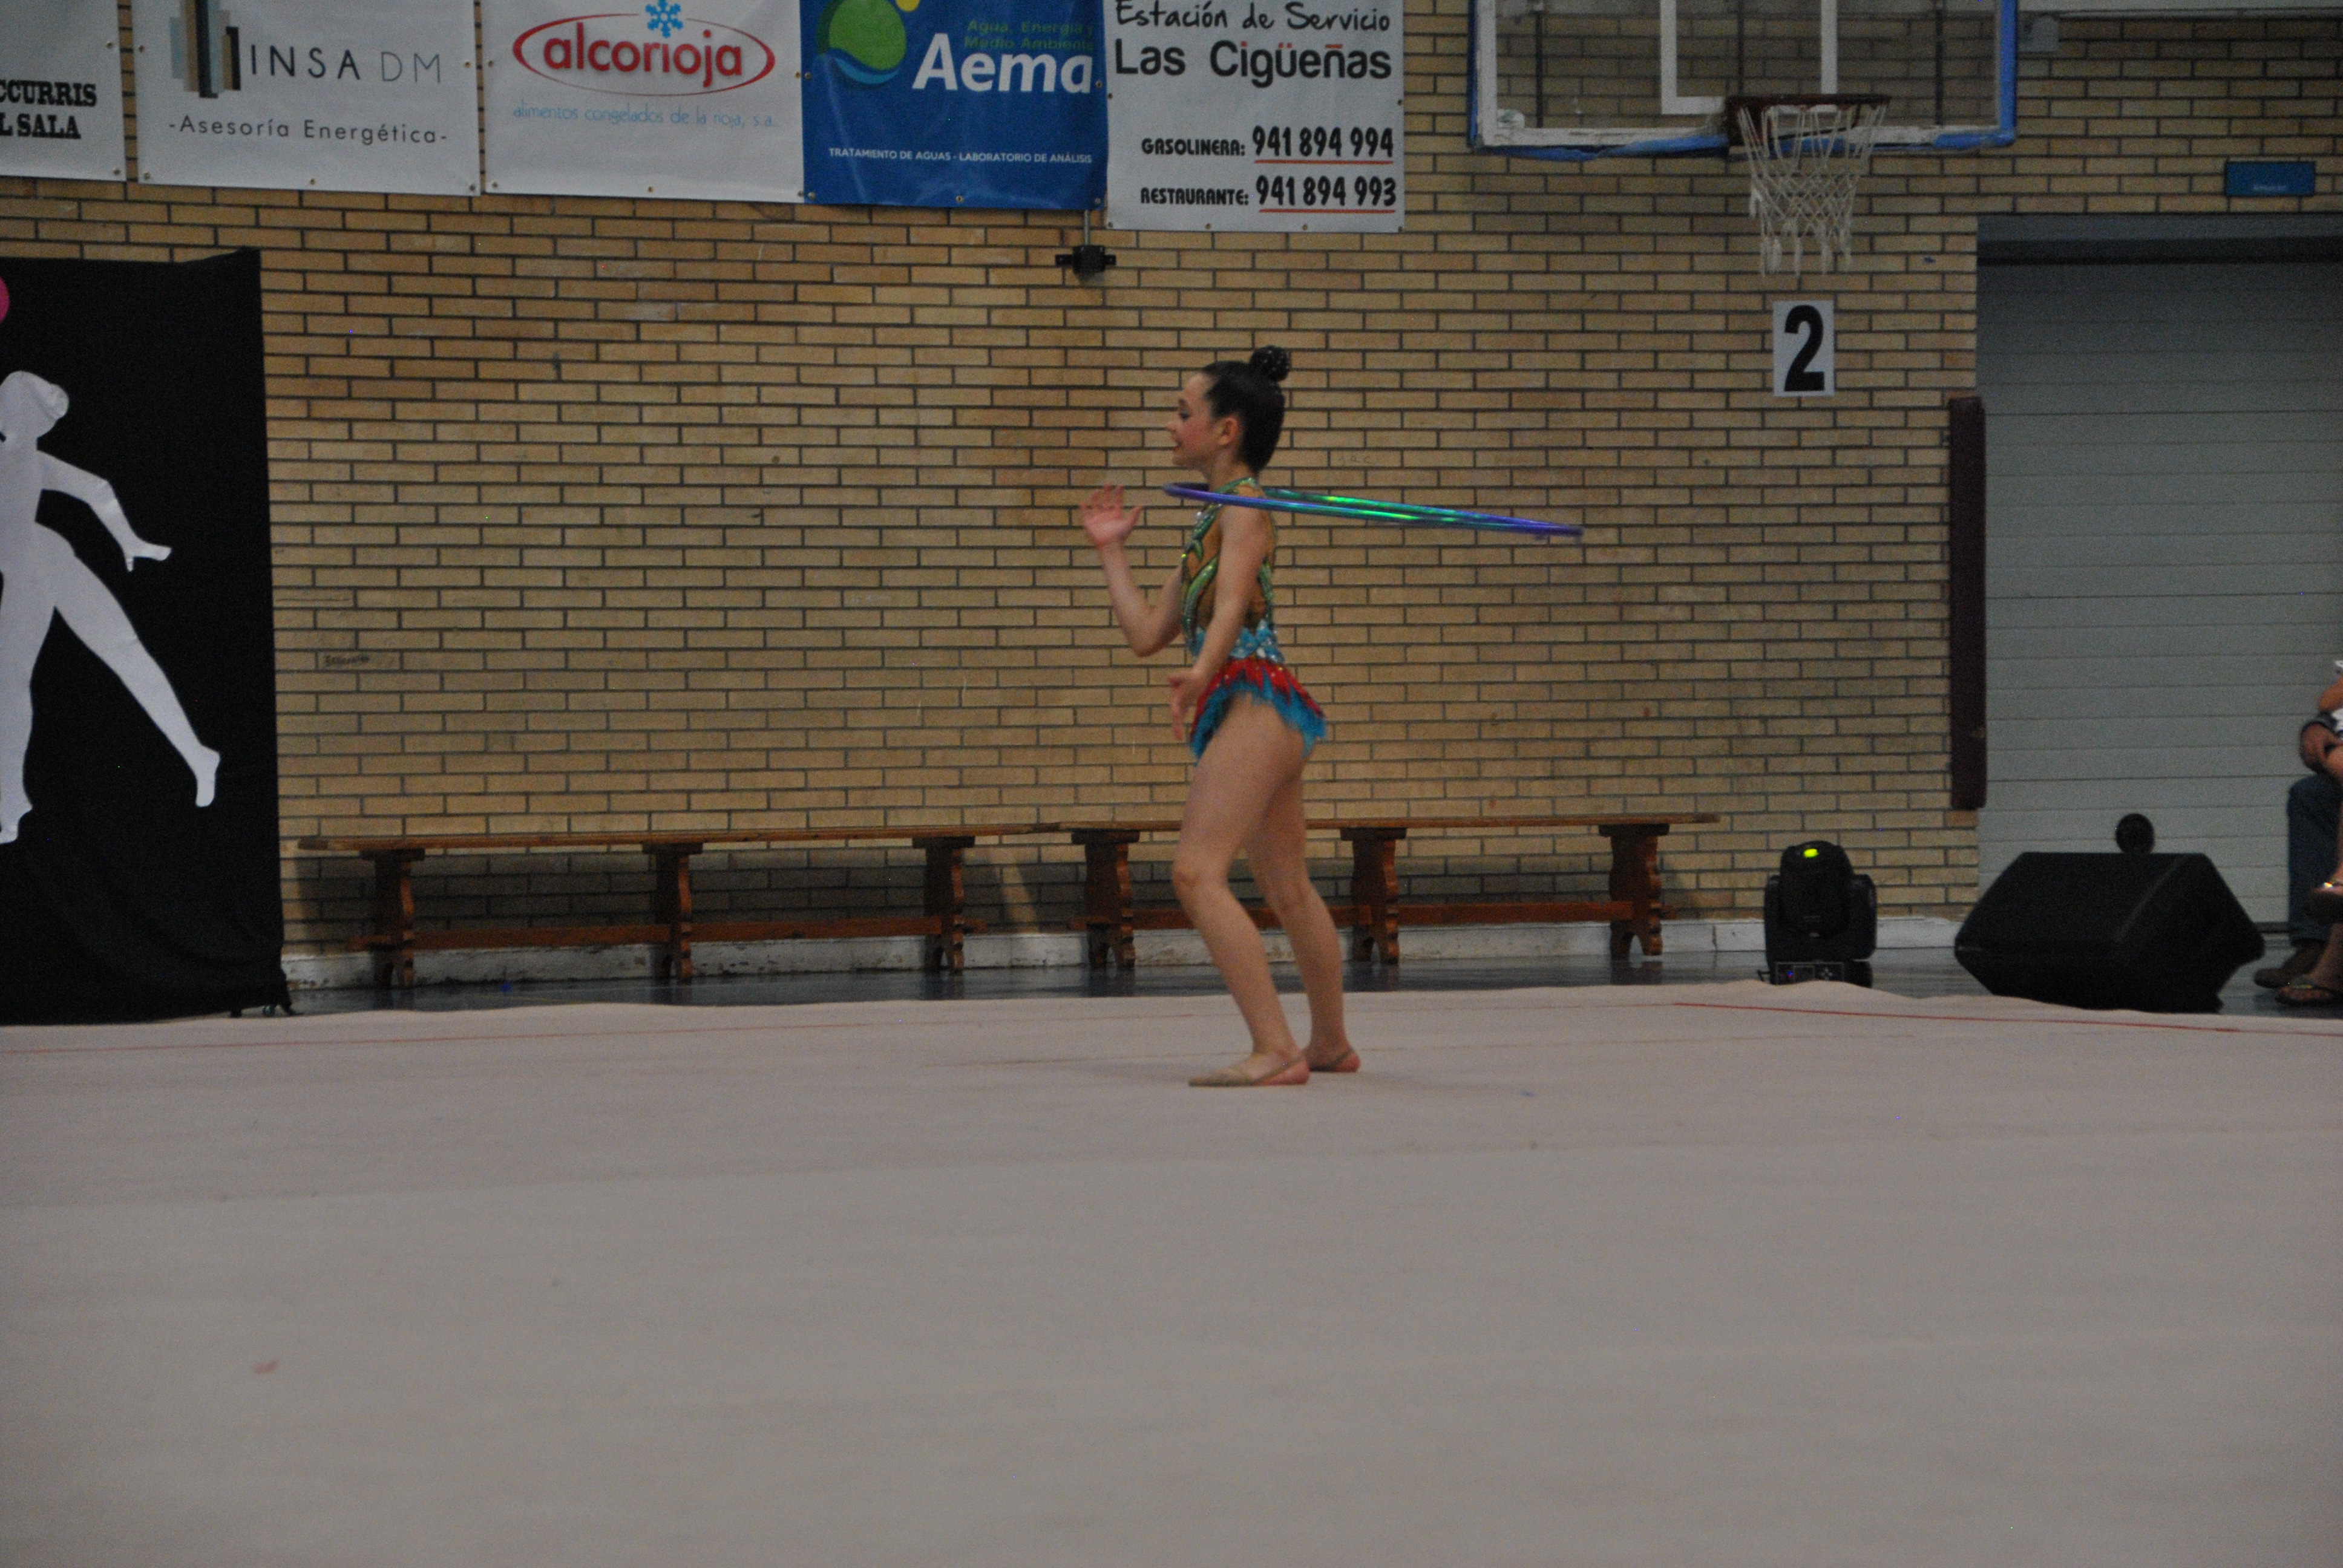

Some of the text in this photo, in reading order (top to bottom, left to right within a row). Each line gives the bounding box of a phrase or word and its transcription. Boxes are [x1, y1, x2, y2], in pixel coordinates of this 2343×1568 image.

[1116, 0, 1390, 31] Estación de Servicio
[251, 44, 441, 83] INSA DM
[543, 22, 742, 88] alcorioja
[912, 32, 1093, 93] Aema
[1115, 38, 1392, 88] Las Cigüeñas
[17, 113, 81, 139] SALA
[670, 105, 690, 125] de
[828, 148, 897, 160] TRATAMIENTO
[900, 151, 913, 160] DE
[916, 151, 951, 162] AGUAS
[959, 152, 1031, 163] LABORATORIO
[1034, 153, 1047, 163] DE
[1141, 125, 1394, 158] GASOLINERA: 941 894 994
[1141, 175, 1396, 207] RESTAURANTE: 941 894 993
[1784, 304, 1825, 391] 2
